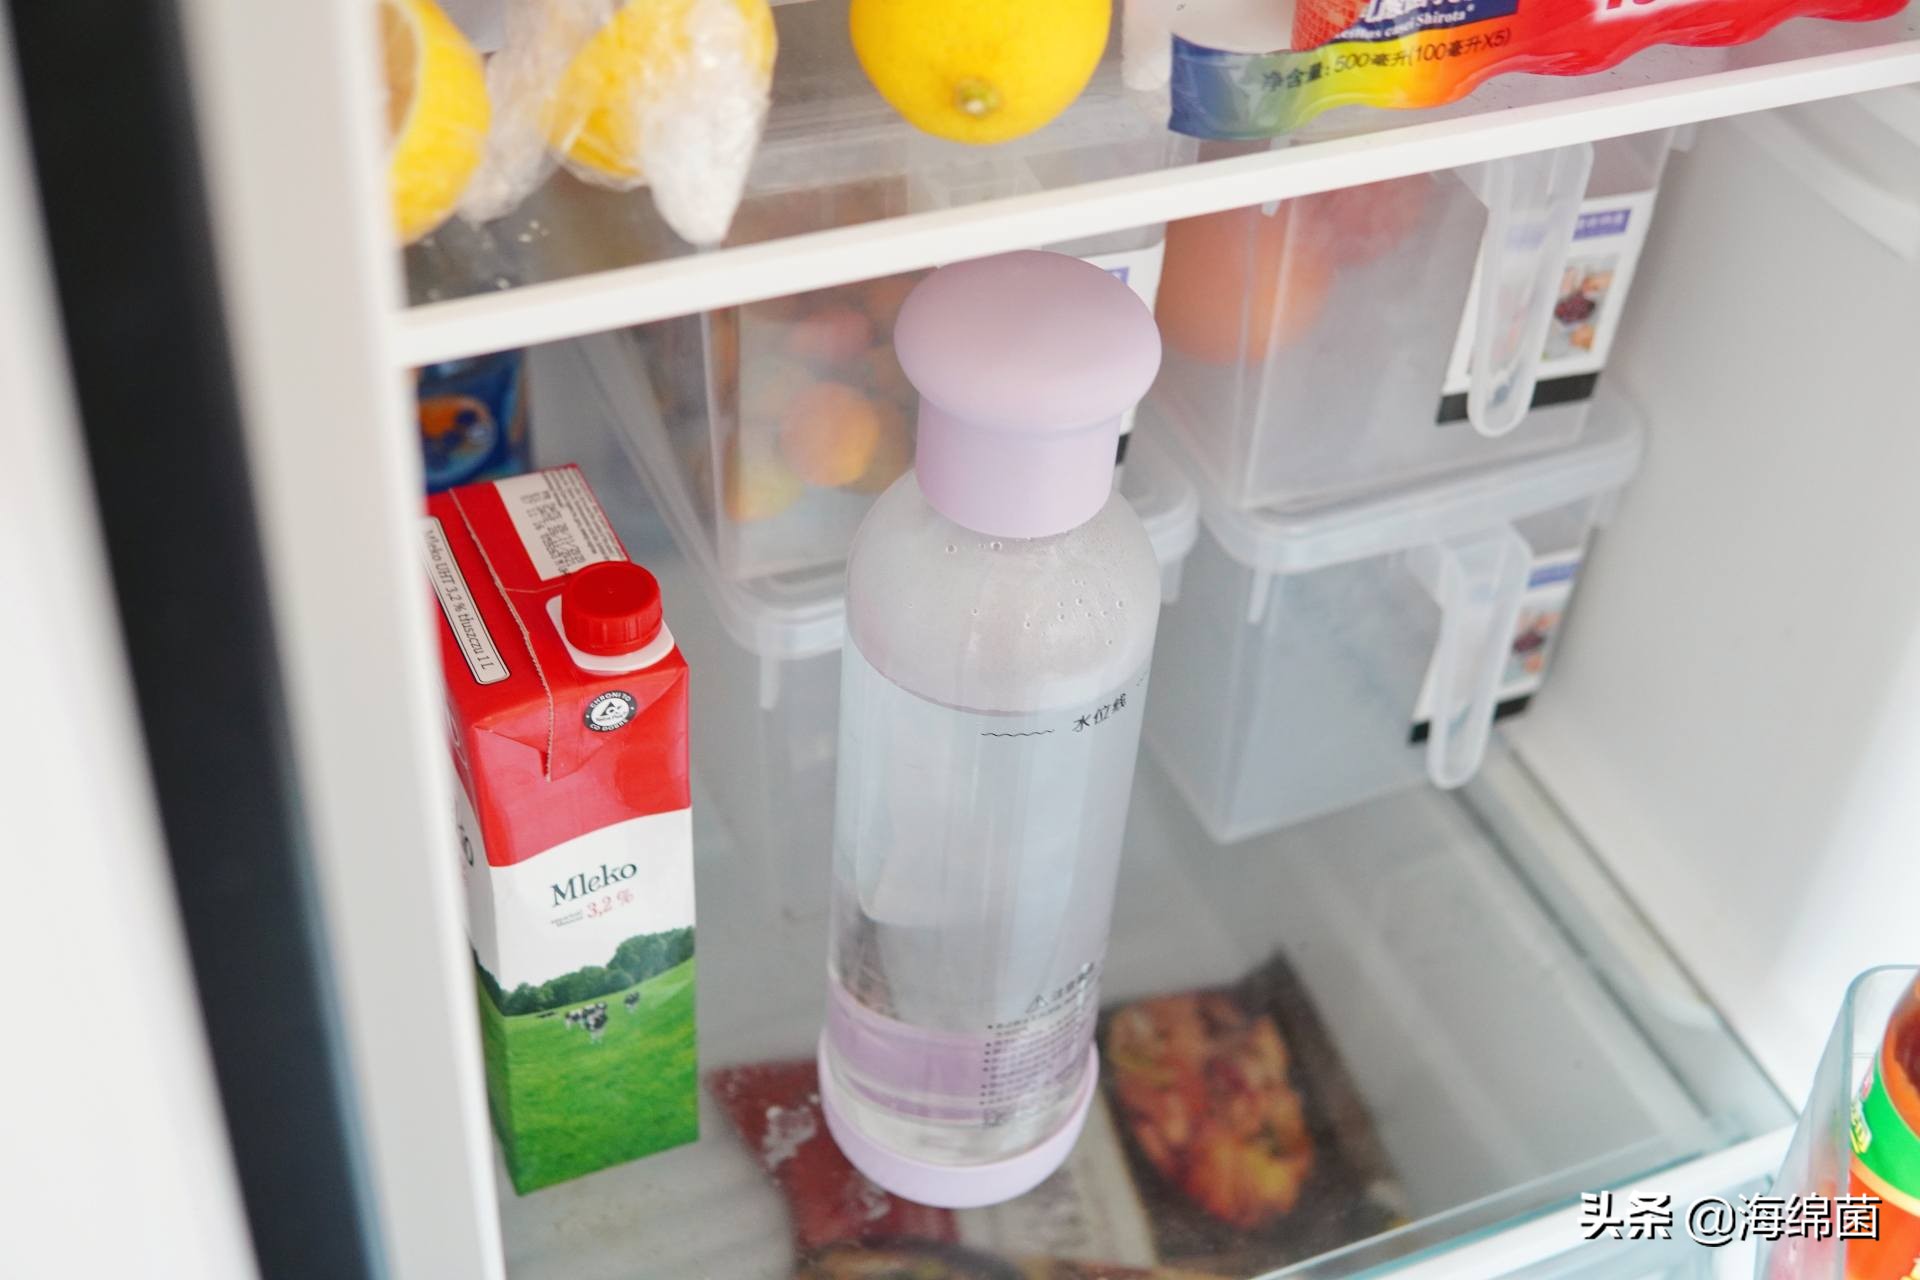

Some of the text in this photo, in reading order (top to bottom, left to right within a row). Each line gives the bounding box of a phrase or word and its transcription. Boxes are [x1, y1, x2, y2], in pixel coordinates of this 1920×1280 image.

[436, 560, 456, 585] UHT
[446, 584, 462, 602] 3,2
[458, 612, 483, 655] tłuszczu
[549, 863, 638, 908] Mleko
[586, 896, 613, 919] 3,2
